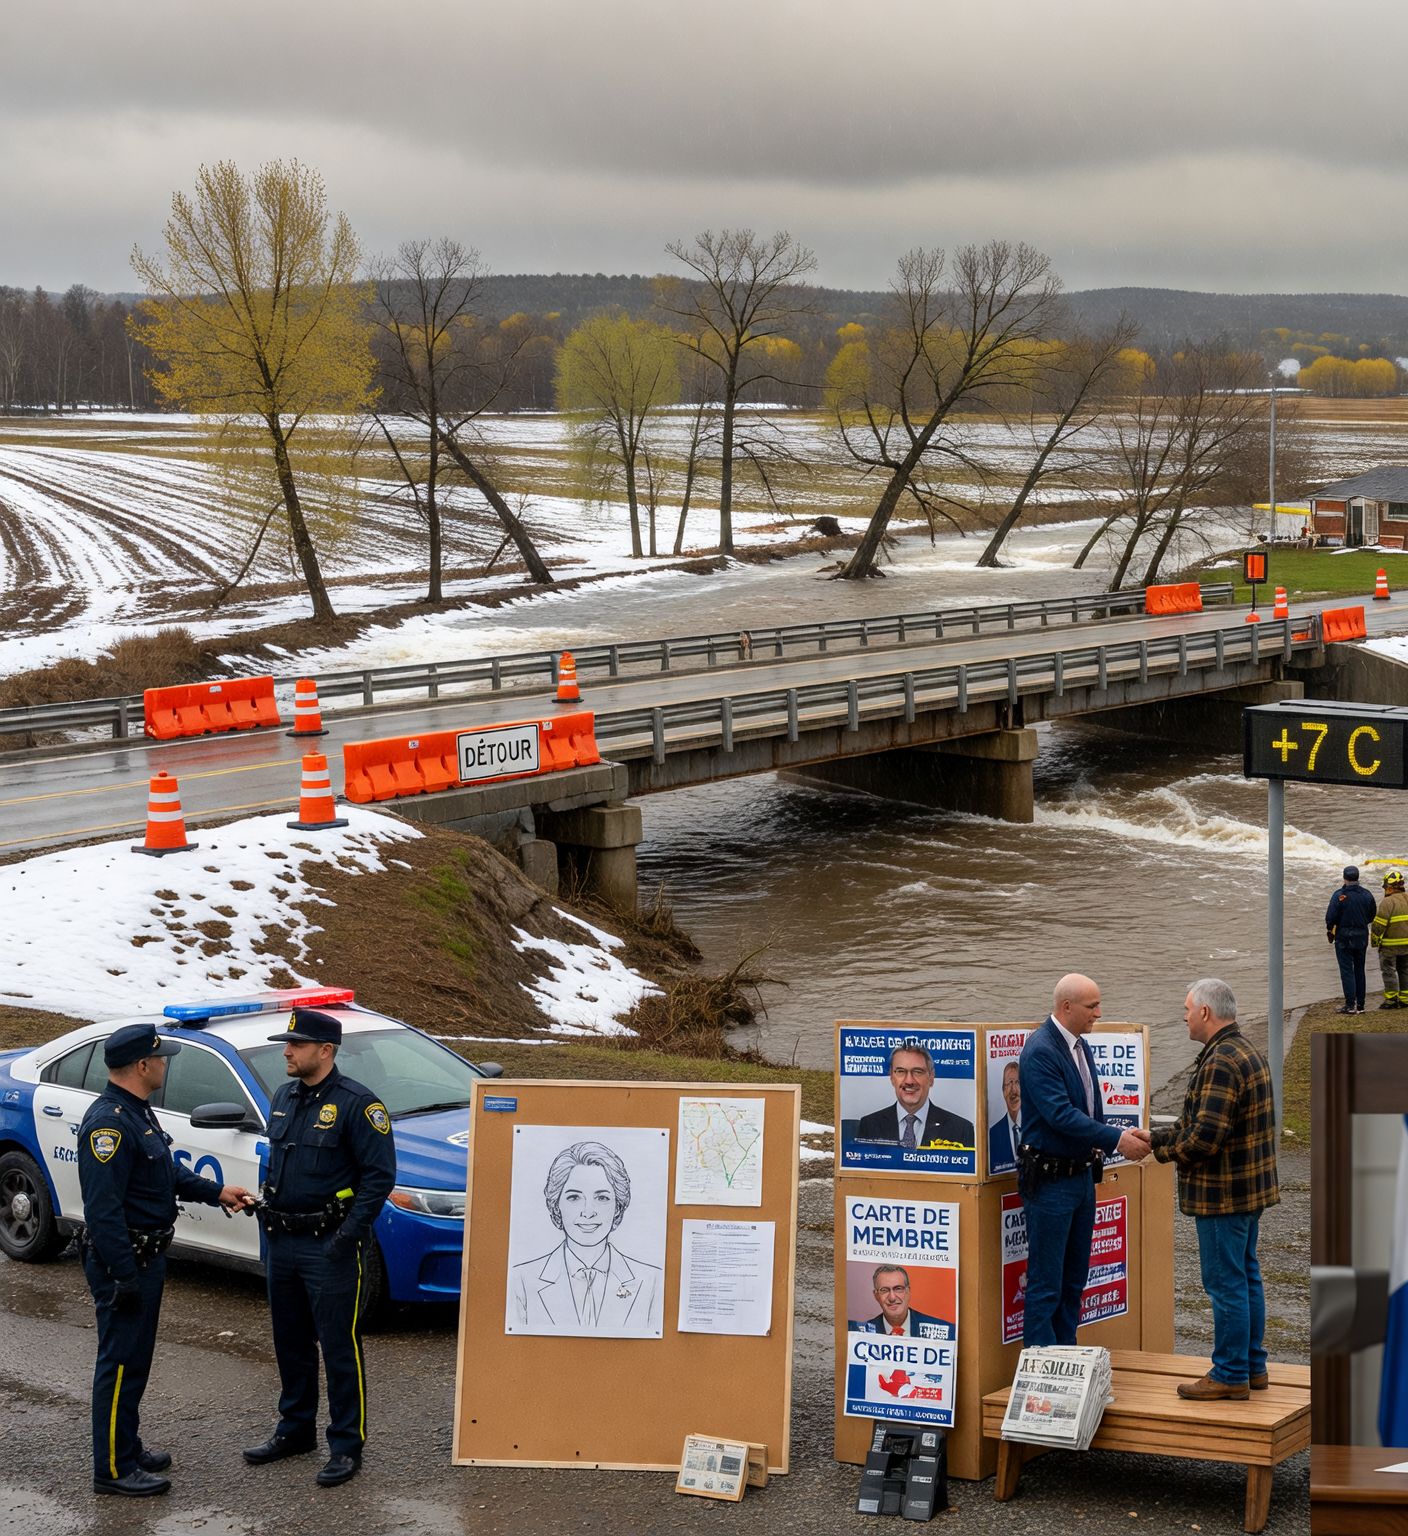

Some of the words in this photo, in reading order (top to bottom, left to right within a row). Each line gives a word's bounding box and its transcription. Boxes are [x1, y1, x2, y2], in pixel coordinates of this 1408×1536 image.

[465, 738, 532, 767] DÉTOUR
[1272, 722, 1328, 771] +7
[1347, 725, 1381, 775] C
[852, 1203, 916, 1224] CARTE
[923, 1208, 950, 1226] DE
[853, 1225, 949, 1251] MEMBRE
[924, 1347, 952, 1366] DE
